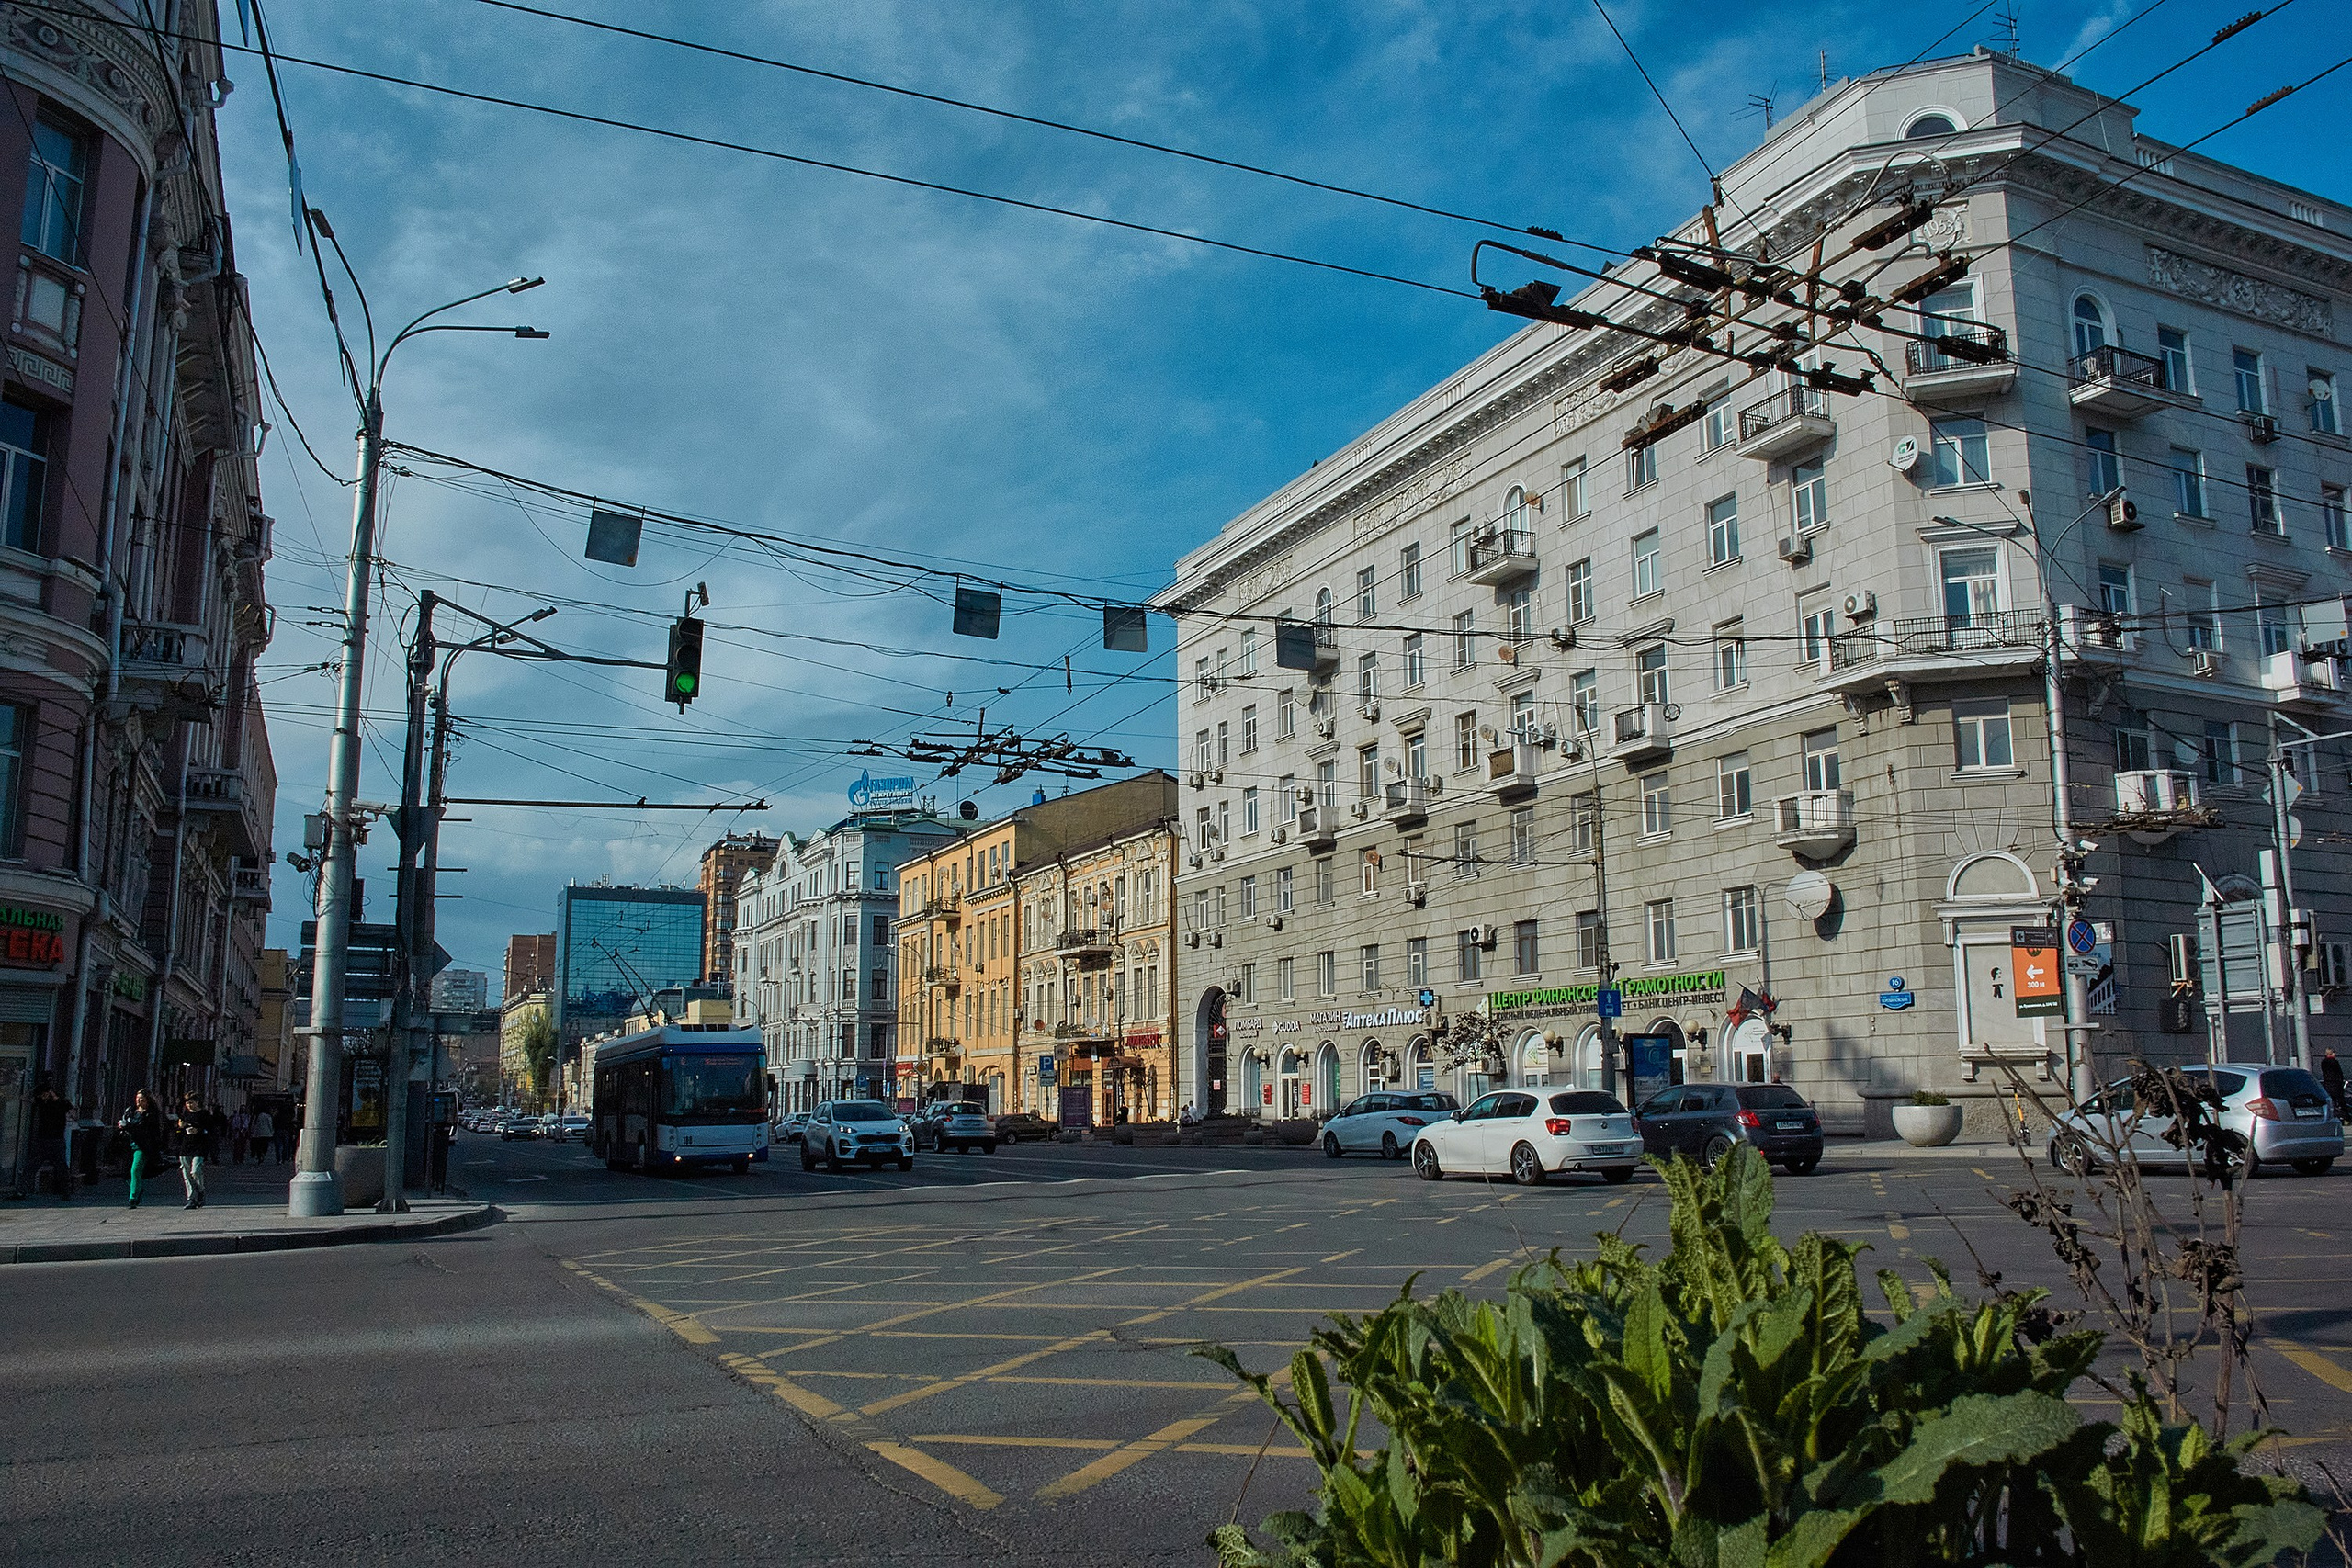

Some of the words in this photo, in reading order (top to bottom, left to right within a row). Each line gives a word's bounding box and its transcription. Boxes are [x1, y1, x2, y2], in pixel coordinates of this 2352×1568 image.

[1493, 991, 1532, 1010] ЦЕНТР
[1620, 970, 1723, 997] ГРАМОТНОСТИ
[1662, 992, 1726, 1009] ЦЕНТР-ИНВЕСТ
[1309, 1010, 1340, 1023] МАГАЗИН
[1234, 1018, 1261, 1030] ЛОМБАРД
[1043, 1056, 1052, 1069] P
